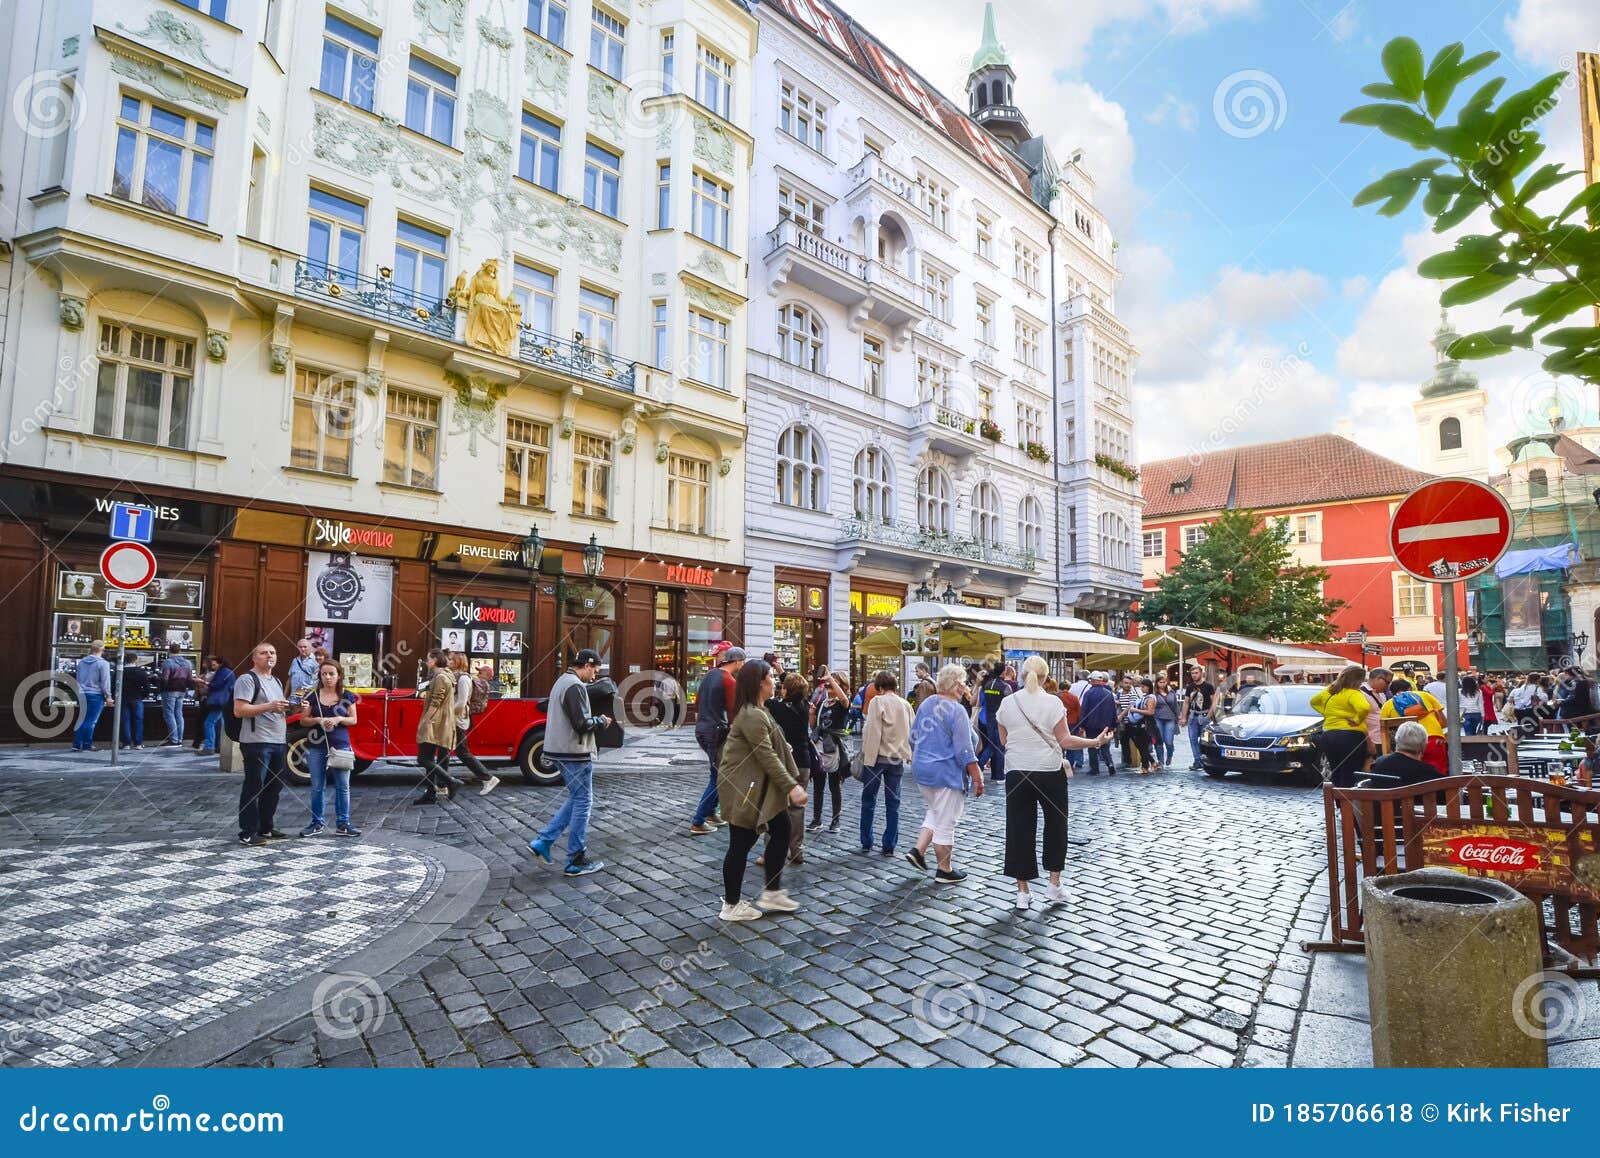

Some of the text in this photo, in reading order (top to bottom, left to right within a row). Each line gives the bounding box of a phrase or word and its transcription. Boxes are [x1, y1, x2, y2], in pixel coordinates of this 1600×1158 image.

[95, 498, 180, 521] WHES
[457, 543, 519, 561] JEWELLERY
[1459, 843, 1526, 865] Coca-Cola
